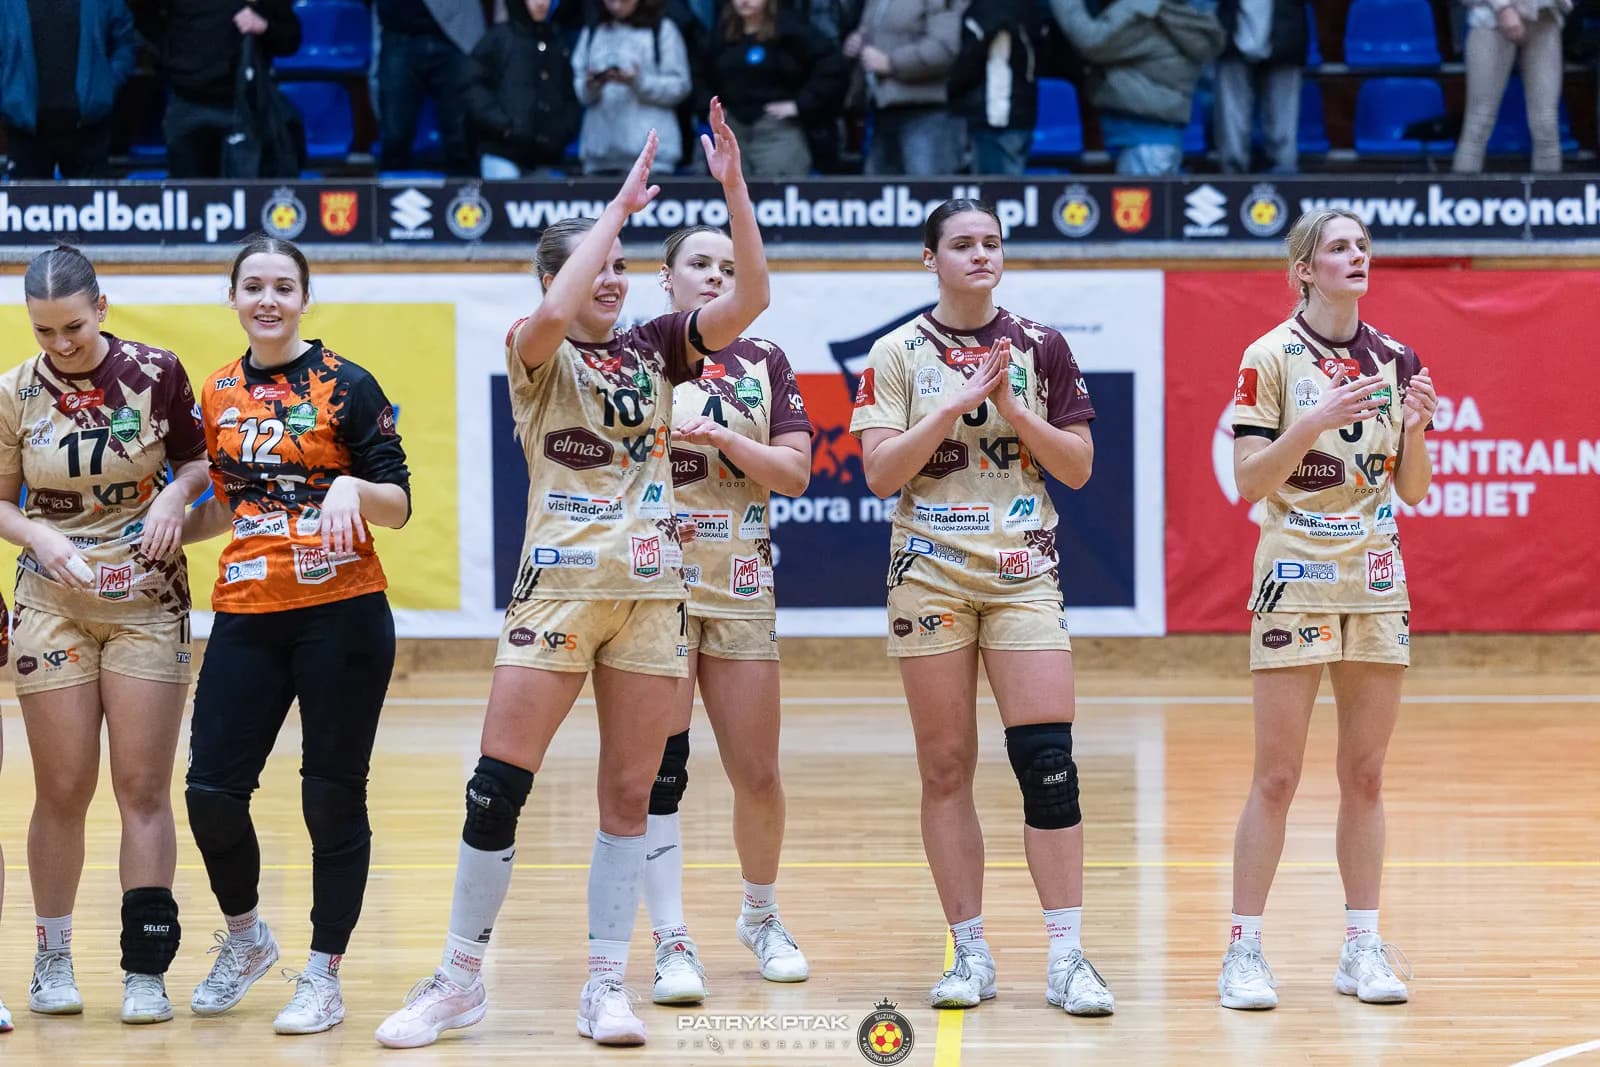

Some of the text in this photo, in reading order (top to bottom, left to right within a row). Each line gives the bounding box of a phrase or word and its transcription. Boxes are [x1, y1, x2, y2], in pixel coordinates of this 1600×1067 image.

[0, 190, 245, 242] handball.pl
[921, 387, 940, 395] DCM
[596, 386, 644, 428] 10
[1433, 396, 1483, 432] GA
[31, 438, 50, 446] DCM
[239, 417, 285, 465] 12
[553, 435, 604, 458] elmas
[59, 428, 109, 477] 17
[933, 448, 958, 464] mas
[1424, 440, 1600, 475] ENTRALN
[671, 460, 698, 473] mas
[93, 473, 154, 505] KPS
[769, 497, 851, 529] pora
[1277, 562, 1334, 580] DARCO
[676, 602, 688, 636] 1
[918, 613, 954, 631] KPS
[511, 631, 532, 641] elmas
[544, 631, 577, 651] KPS
[1265, 633, 1288, 642] elmas
[1299, 625, 1332, 643] KPS
[43, 648, 80, 666] KPS
[655, 775, 677, 783] ELECT
[1043, 771, 1067, 783] SELECT
[144, 924, 170, 932] SELECT
